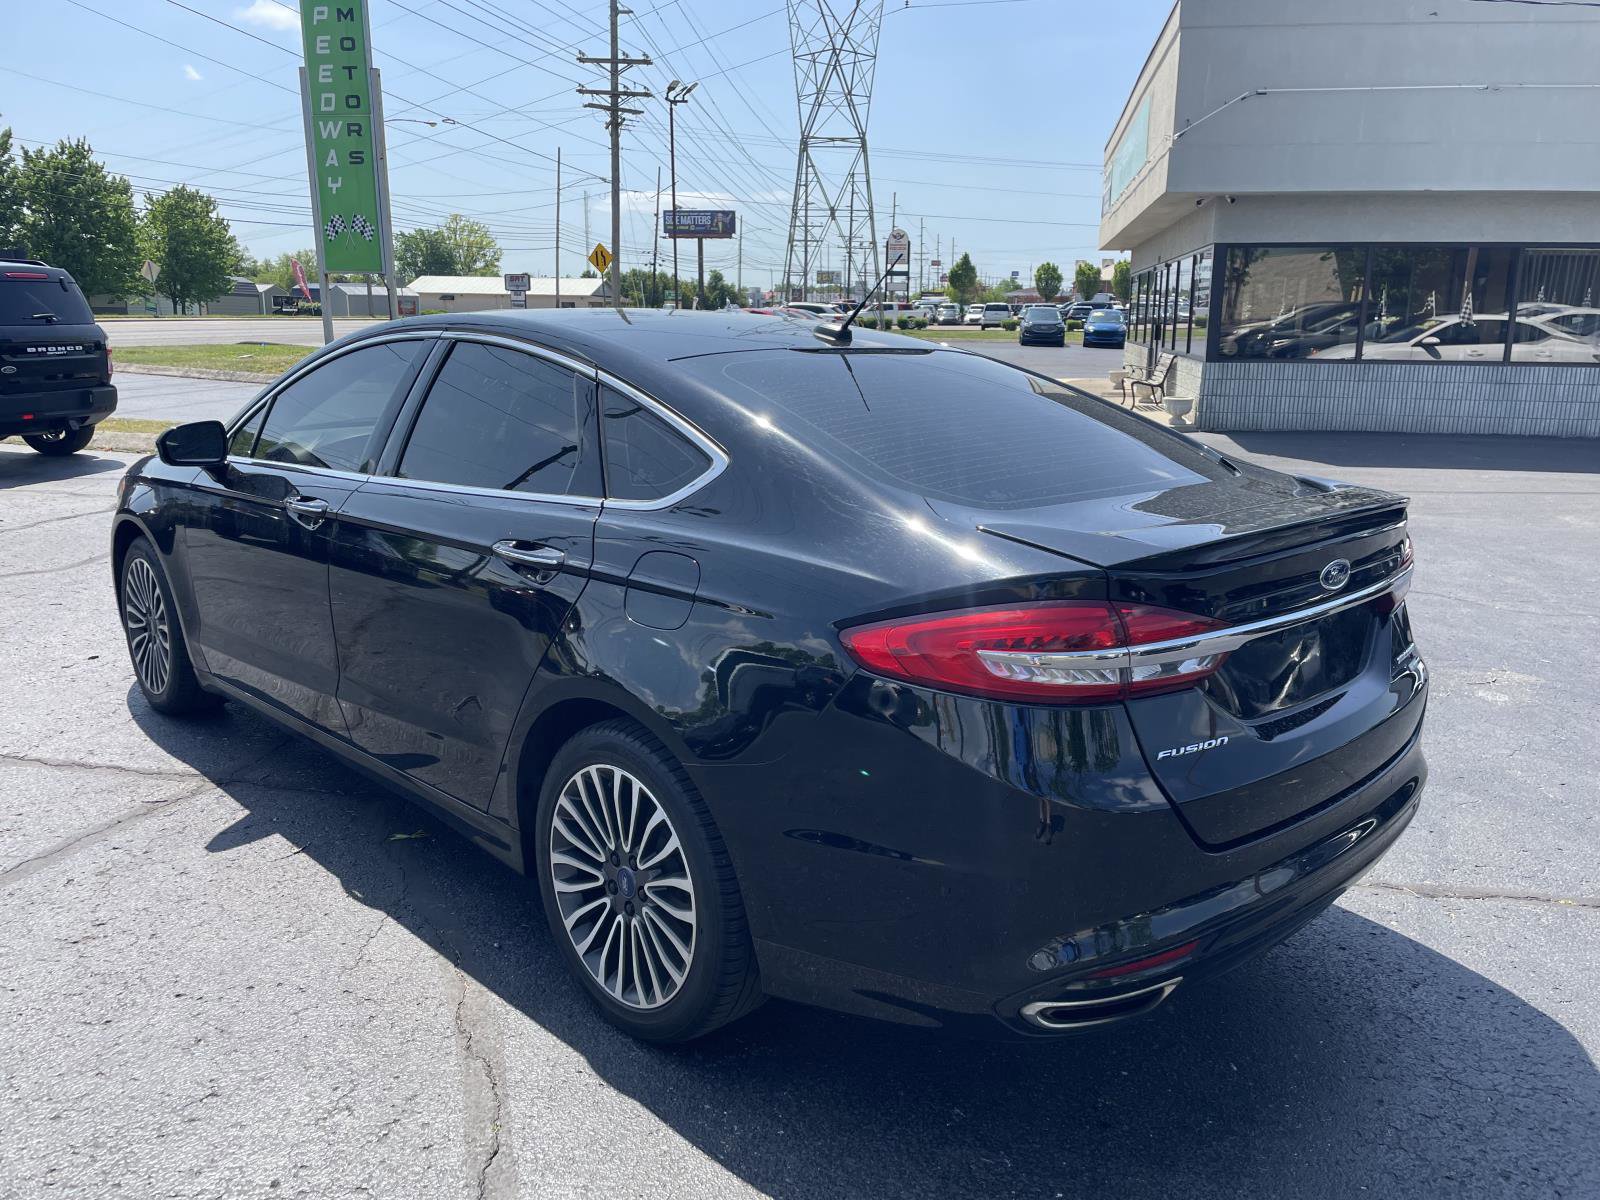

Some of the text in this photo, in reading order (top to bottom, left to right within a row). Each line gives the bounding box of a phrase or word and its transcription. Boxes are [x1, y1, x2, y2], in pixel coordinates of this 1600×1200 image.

[313, 6, 343, 194] PEEDWAY
[336, 8, 365, 165] MOTORS
[665, 215, 712, 225] SIE MATTERS
[1156, 736, 1229, 761] FUSION
